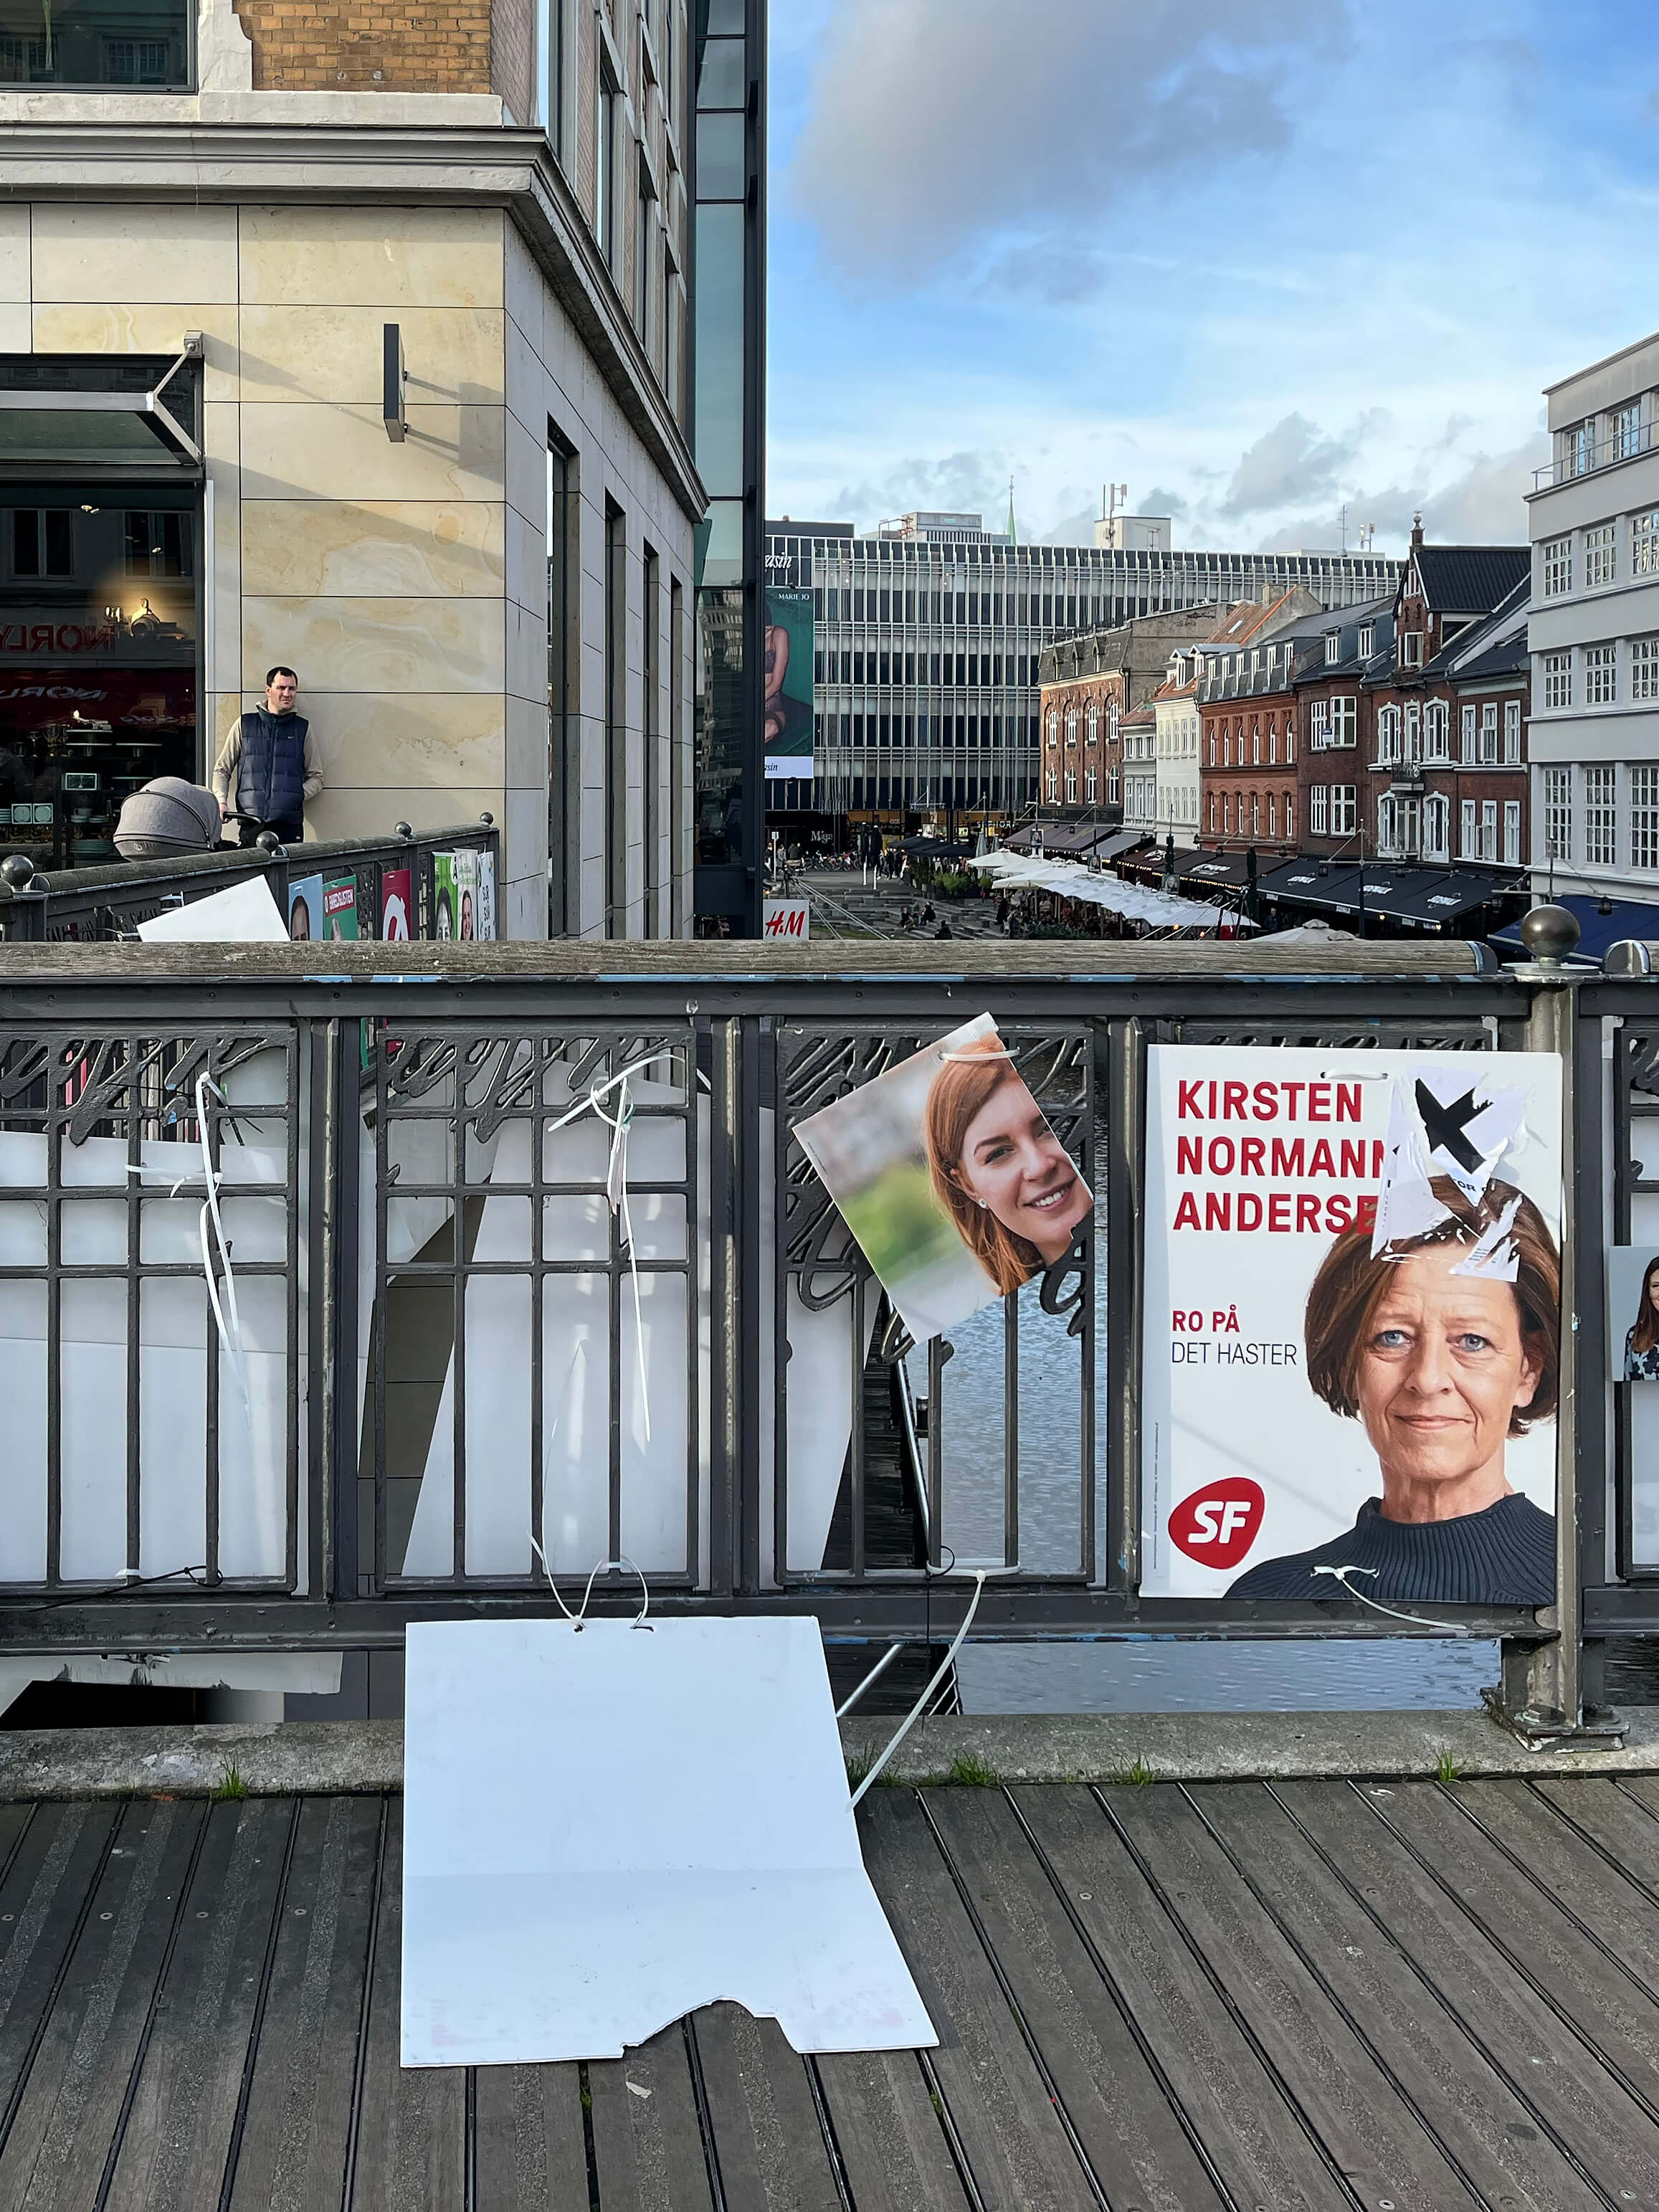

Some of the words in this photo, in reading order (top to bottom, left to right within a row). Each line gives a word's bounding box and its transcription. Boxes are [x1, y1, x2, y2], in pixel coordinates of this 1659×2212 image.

[766, 911, 805, 937] H&M
[1178, 1080, 1361, 1122] KIRSTEN
[1173, 1192, 1379, 1234] ANDERSE
[1172, 1311, 1203, 1332] RO
[1212, 1304, 1240, 1333] PÅ
[1171, 1342, 1212, 1363] DET
[1217, 1342, 1297, 1365] HASTER
[1188, 1501, 1251, 1543] SF
